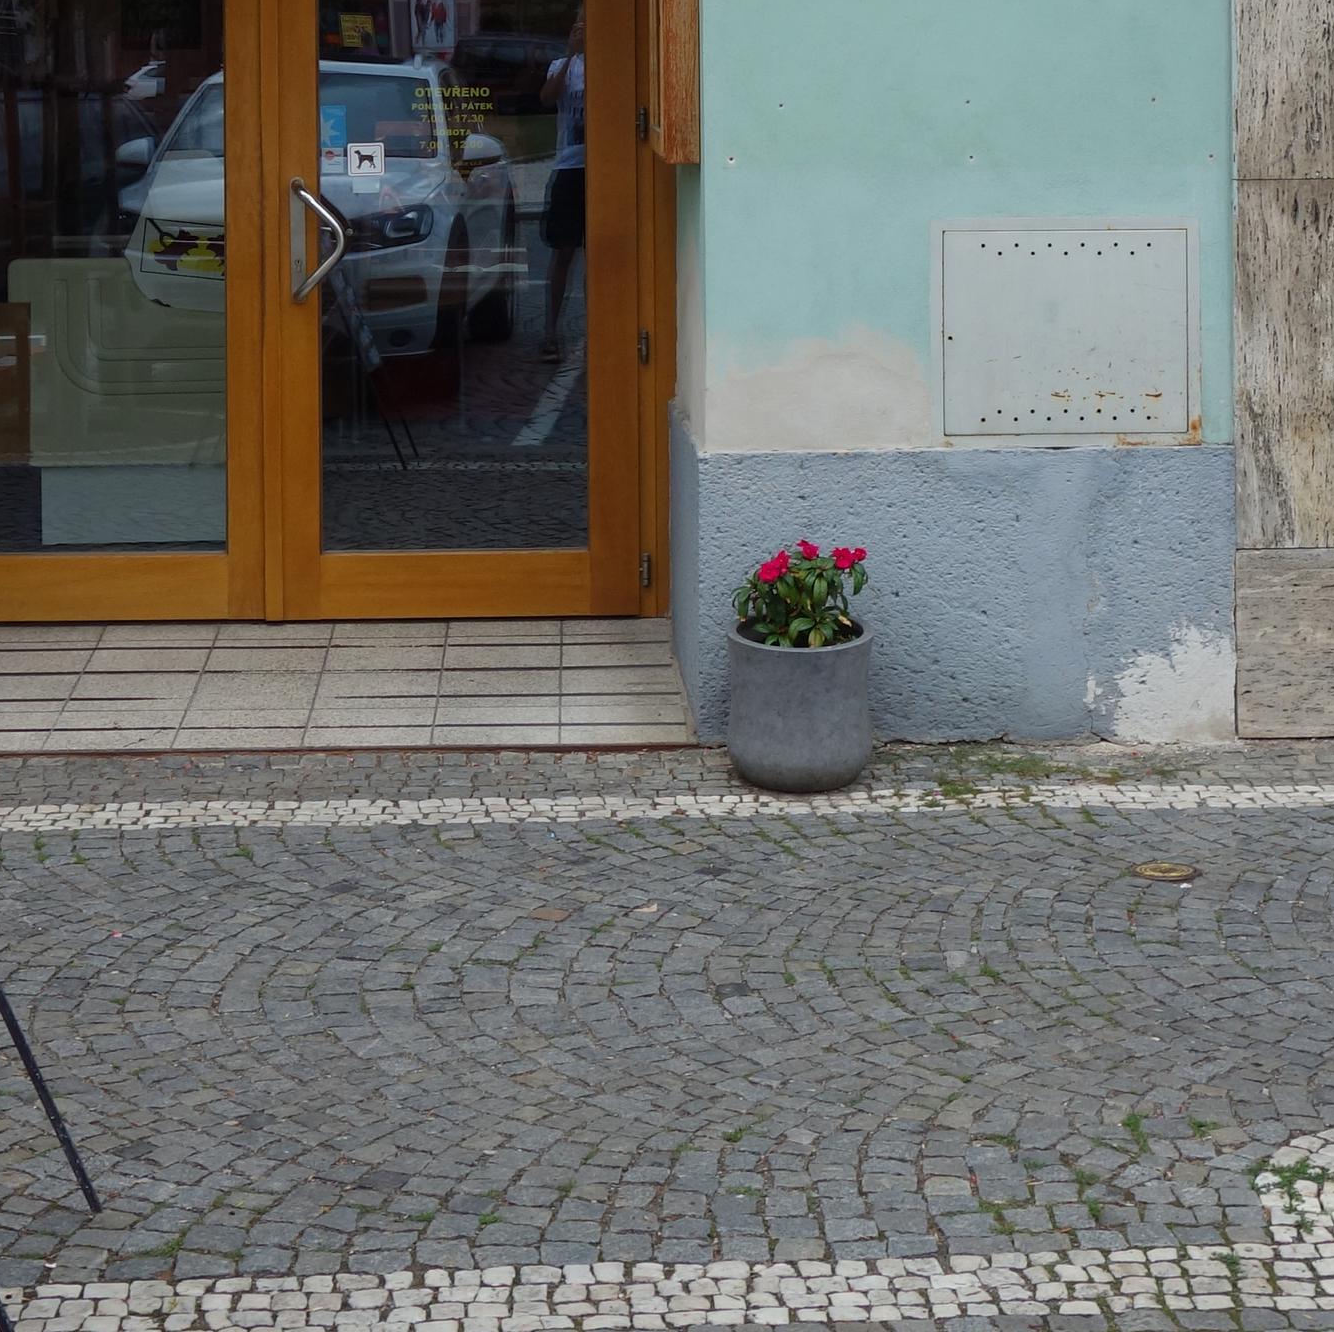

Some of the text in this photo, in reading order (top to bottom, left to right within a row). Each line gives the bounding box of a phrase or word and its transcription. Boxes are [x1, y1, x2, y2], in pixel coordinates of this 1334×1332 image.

[415, 85, 490, 97] OTEVŘENO
[411, 101, 453, 110] PONDĚLÍ
[461, 101, 493, 110] PÁTEK
[455, 114, 484, 123] 17.30
[453, 140, 484, 149] 12.00
